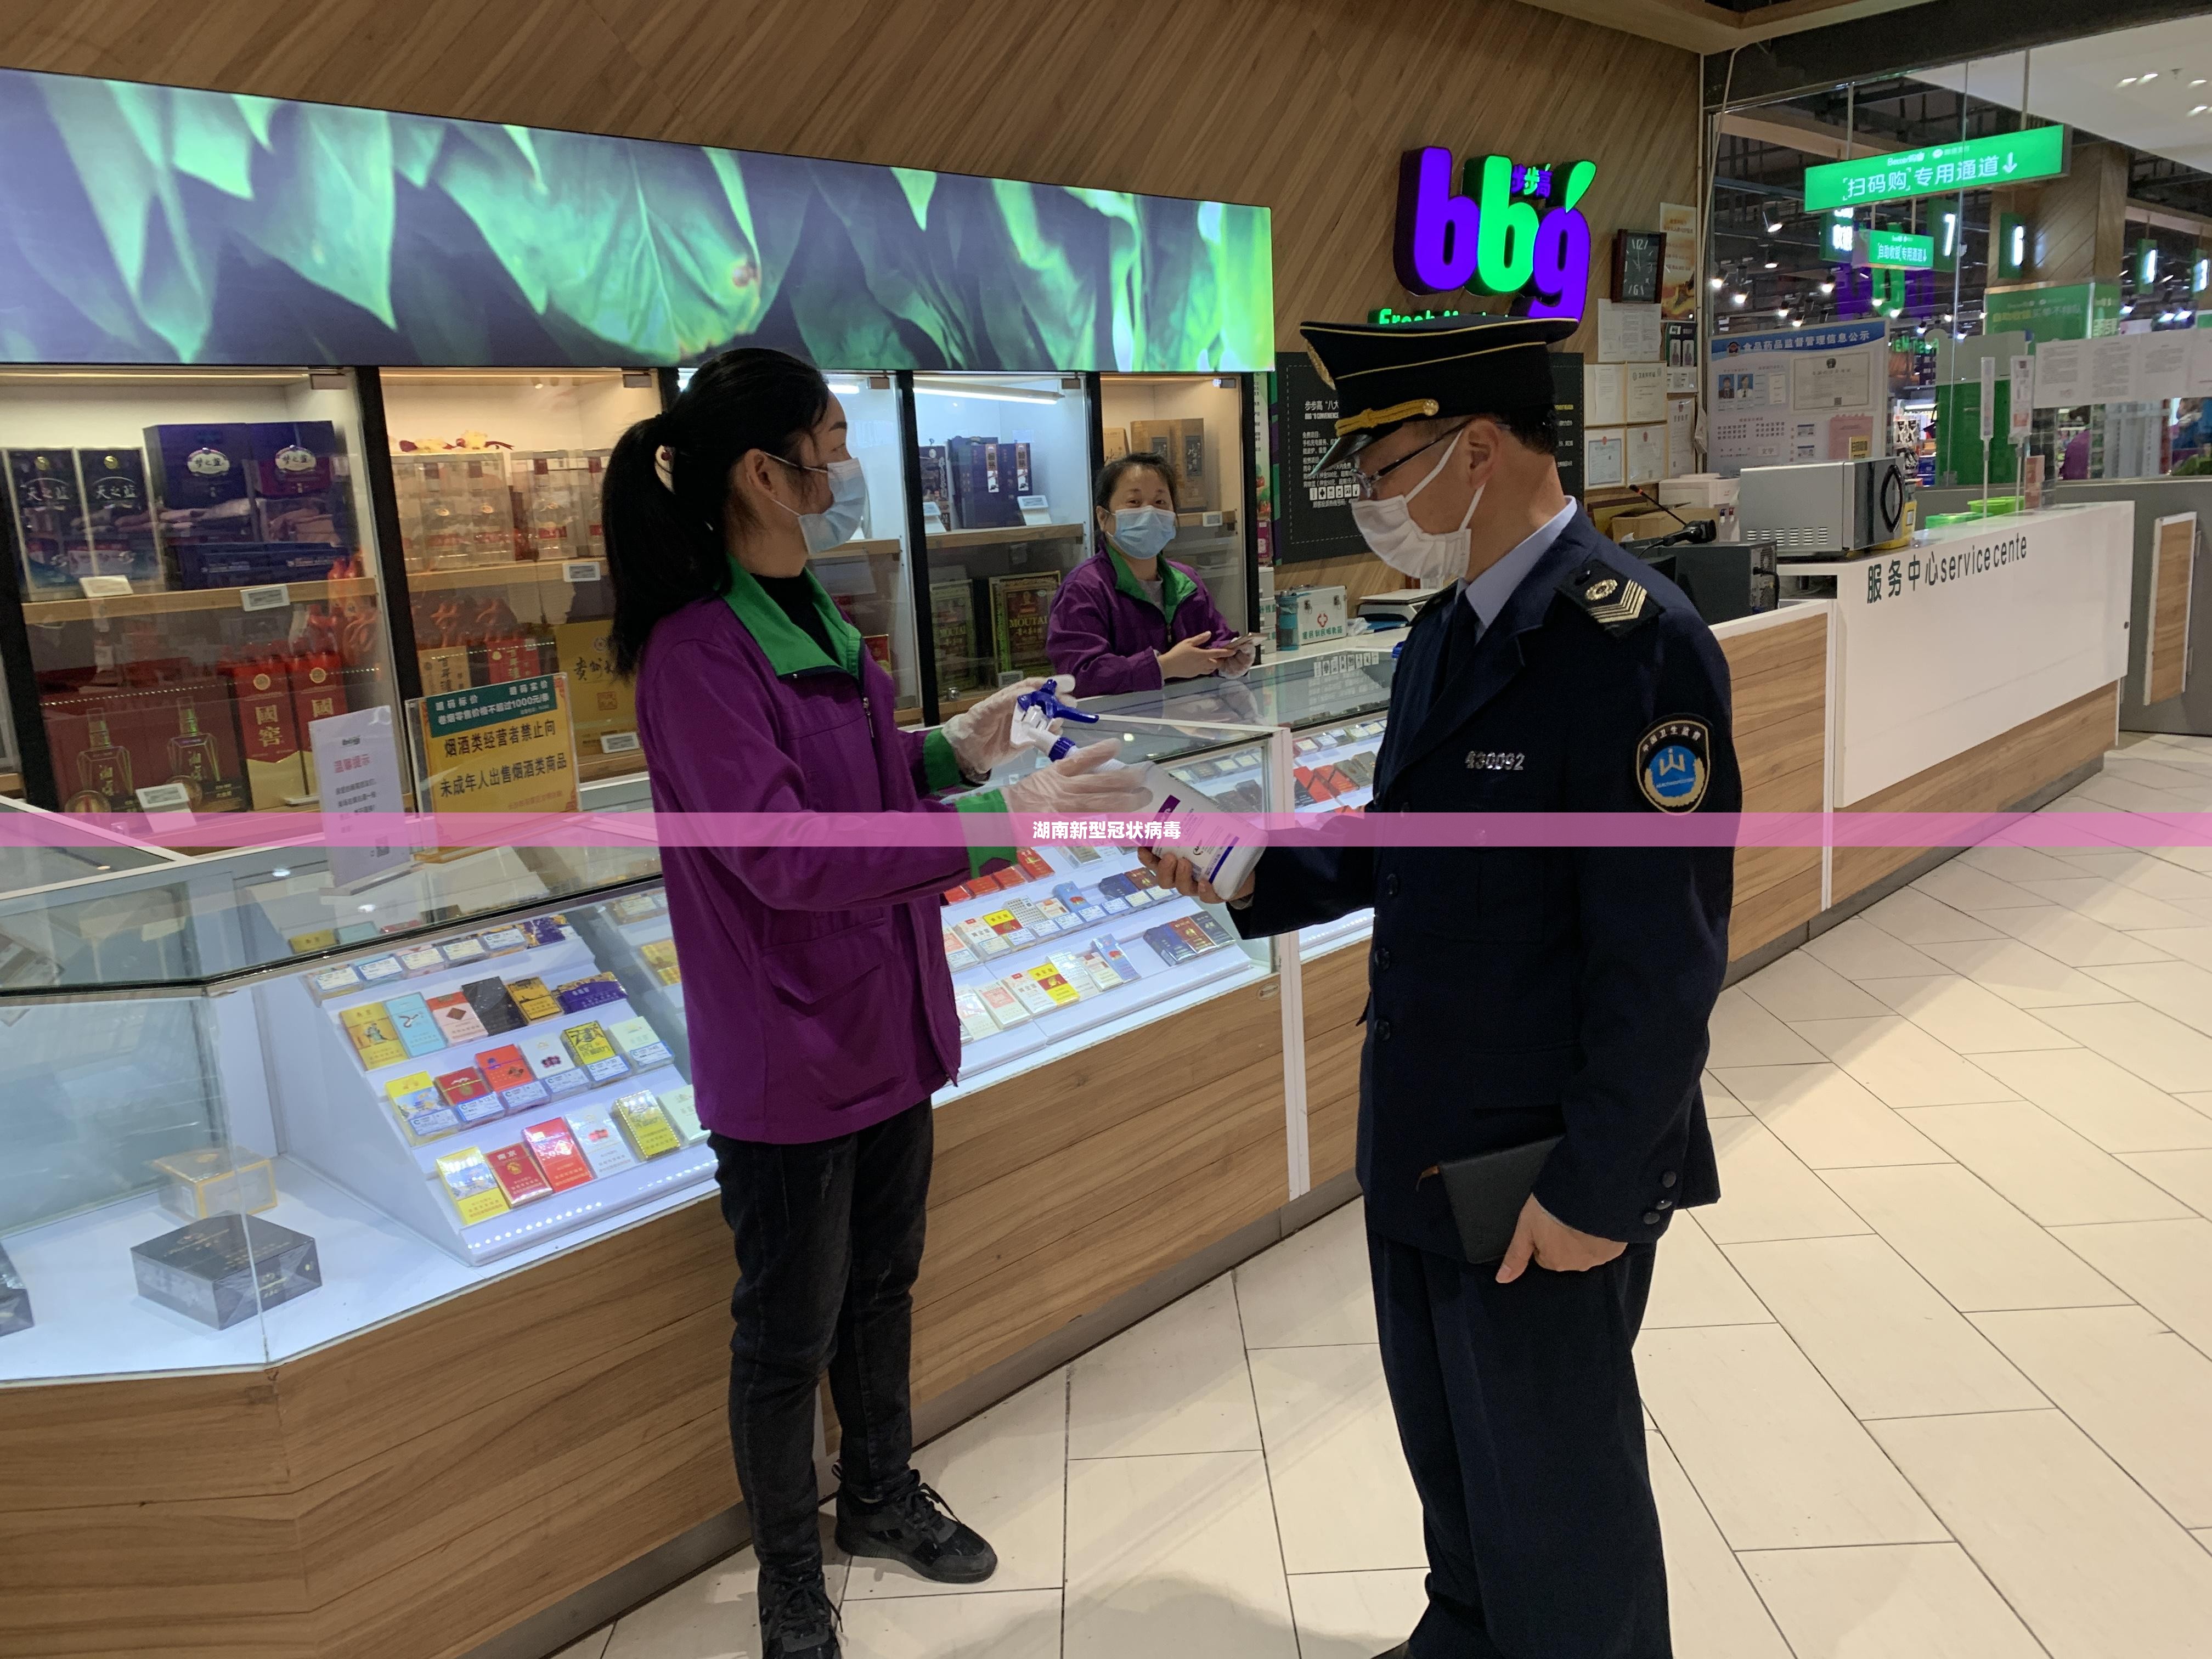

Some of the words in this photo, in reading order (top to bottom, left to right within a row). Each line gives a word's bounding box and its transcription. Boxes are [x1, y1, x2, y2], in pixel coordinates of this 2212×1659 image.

[1511, 163, 1553, 198] 步步高
[1867, 551, 1938, 604] 服务中心
[444, 719, 556, 758] 烟酒类经营者禁止向
[440, 752, 567, 798] 未成年人出售烟酒类商品
